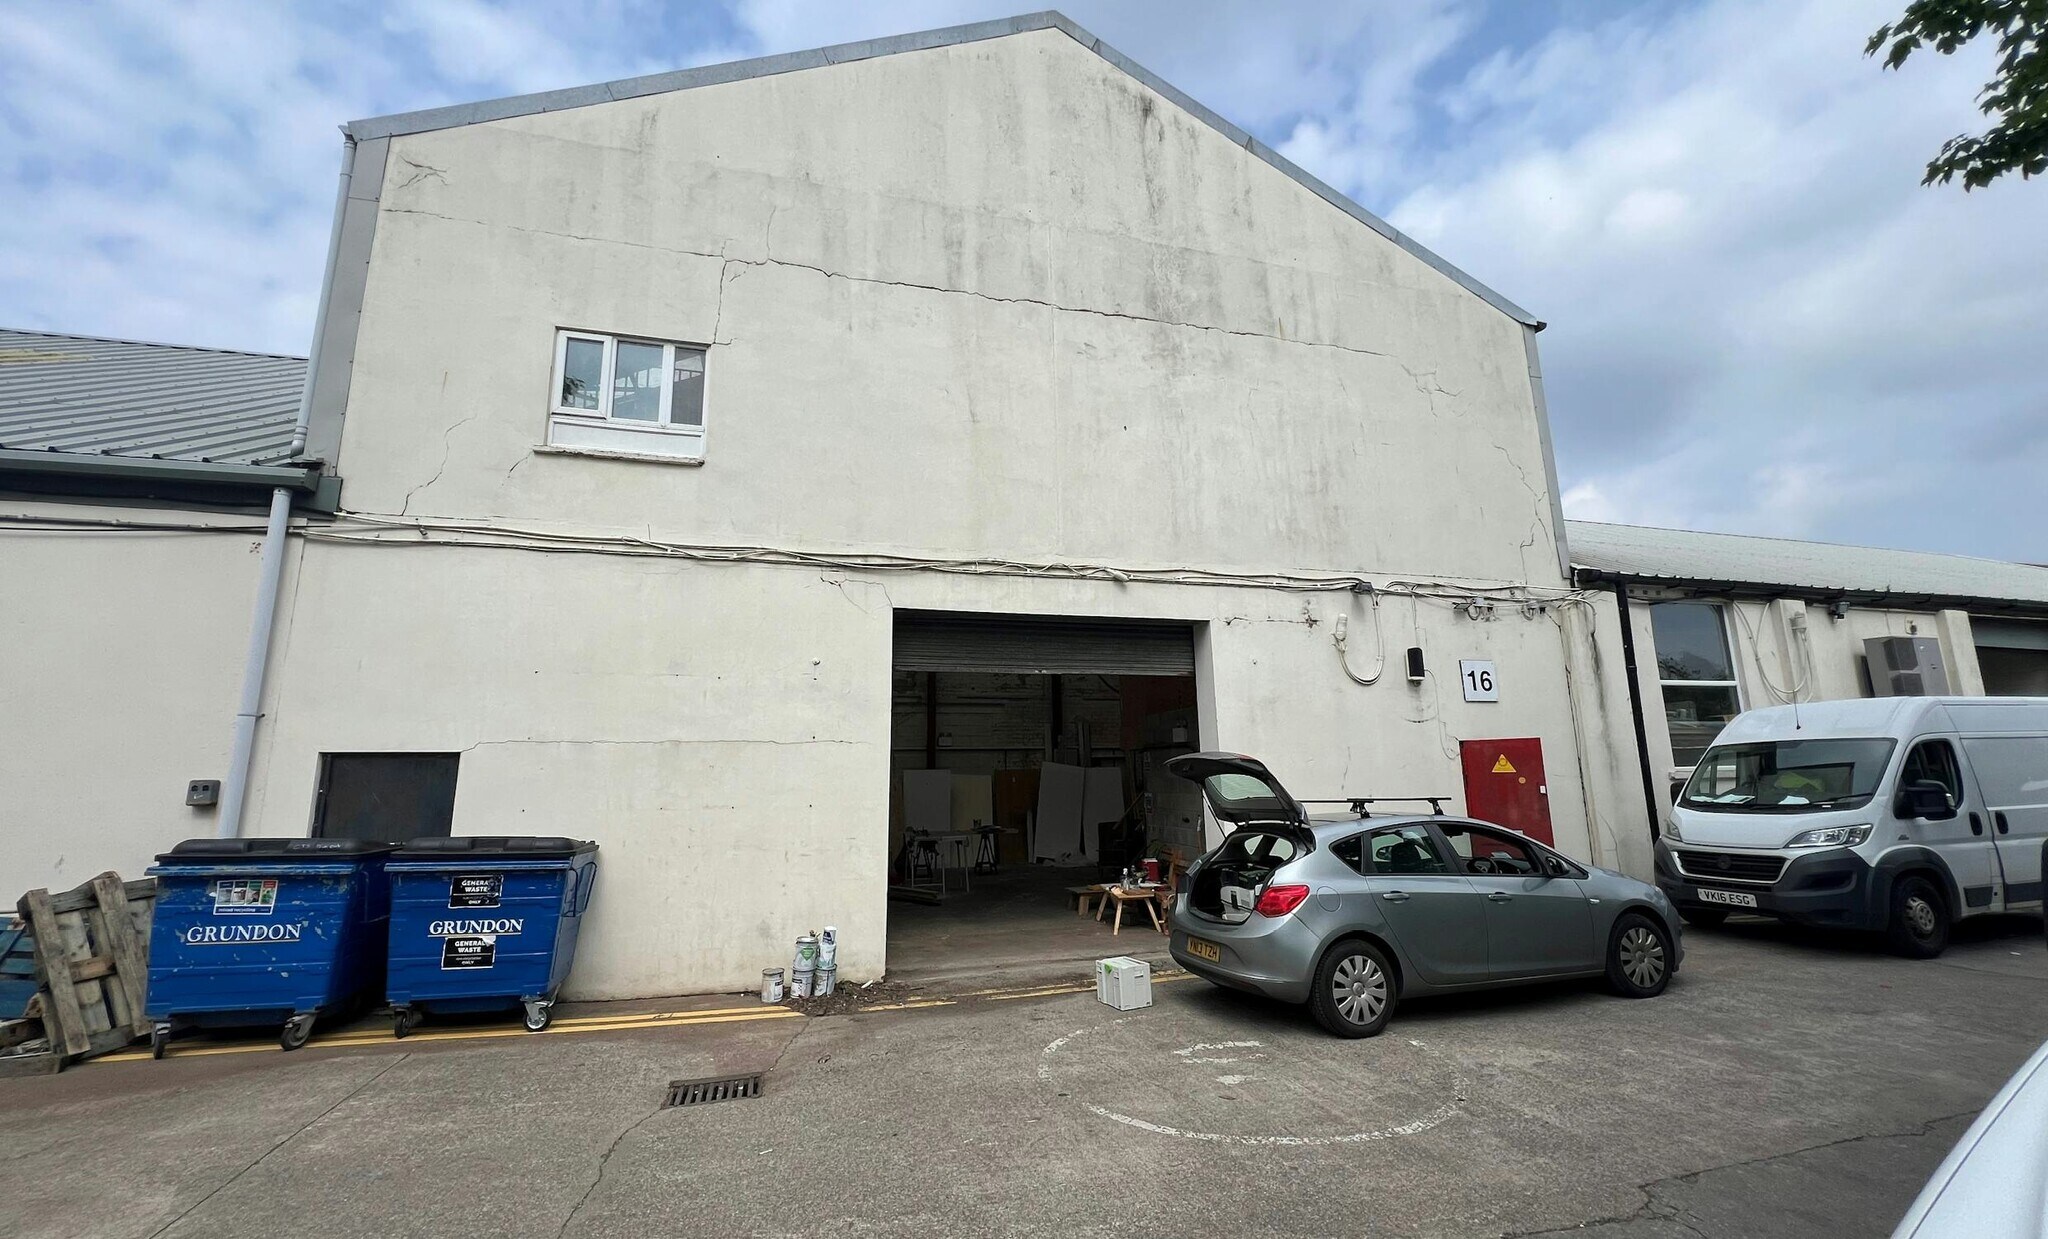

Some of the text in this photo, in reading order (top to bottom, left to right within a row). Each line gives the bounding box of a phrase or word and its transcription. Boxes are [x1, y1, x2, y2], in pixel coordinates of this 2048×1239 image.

[1467, 670, 1493, 692] 16
[1703, 890, 1750, 905] VK16 ESG
[187, 924, 301, 942] GRUNDON
[429, 919, 523, 935] GRUNDON
